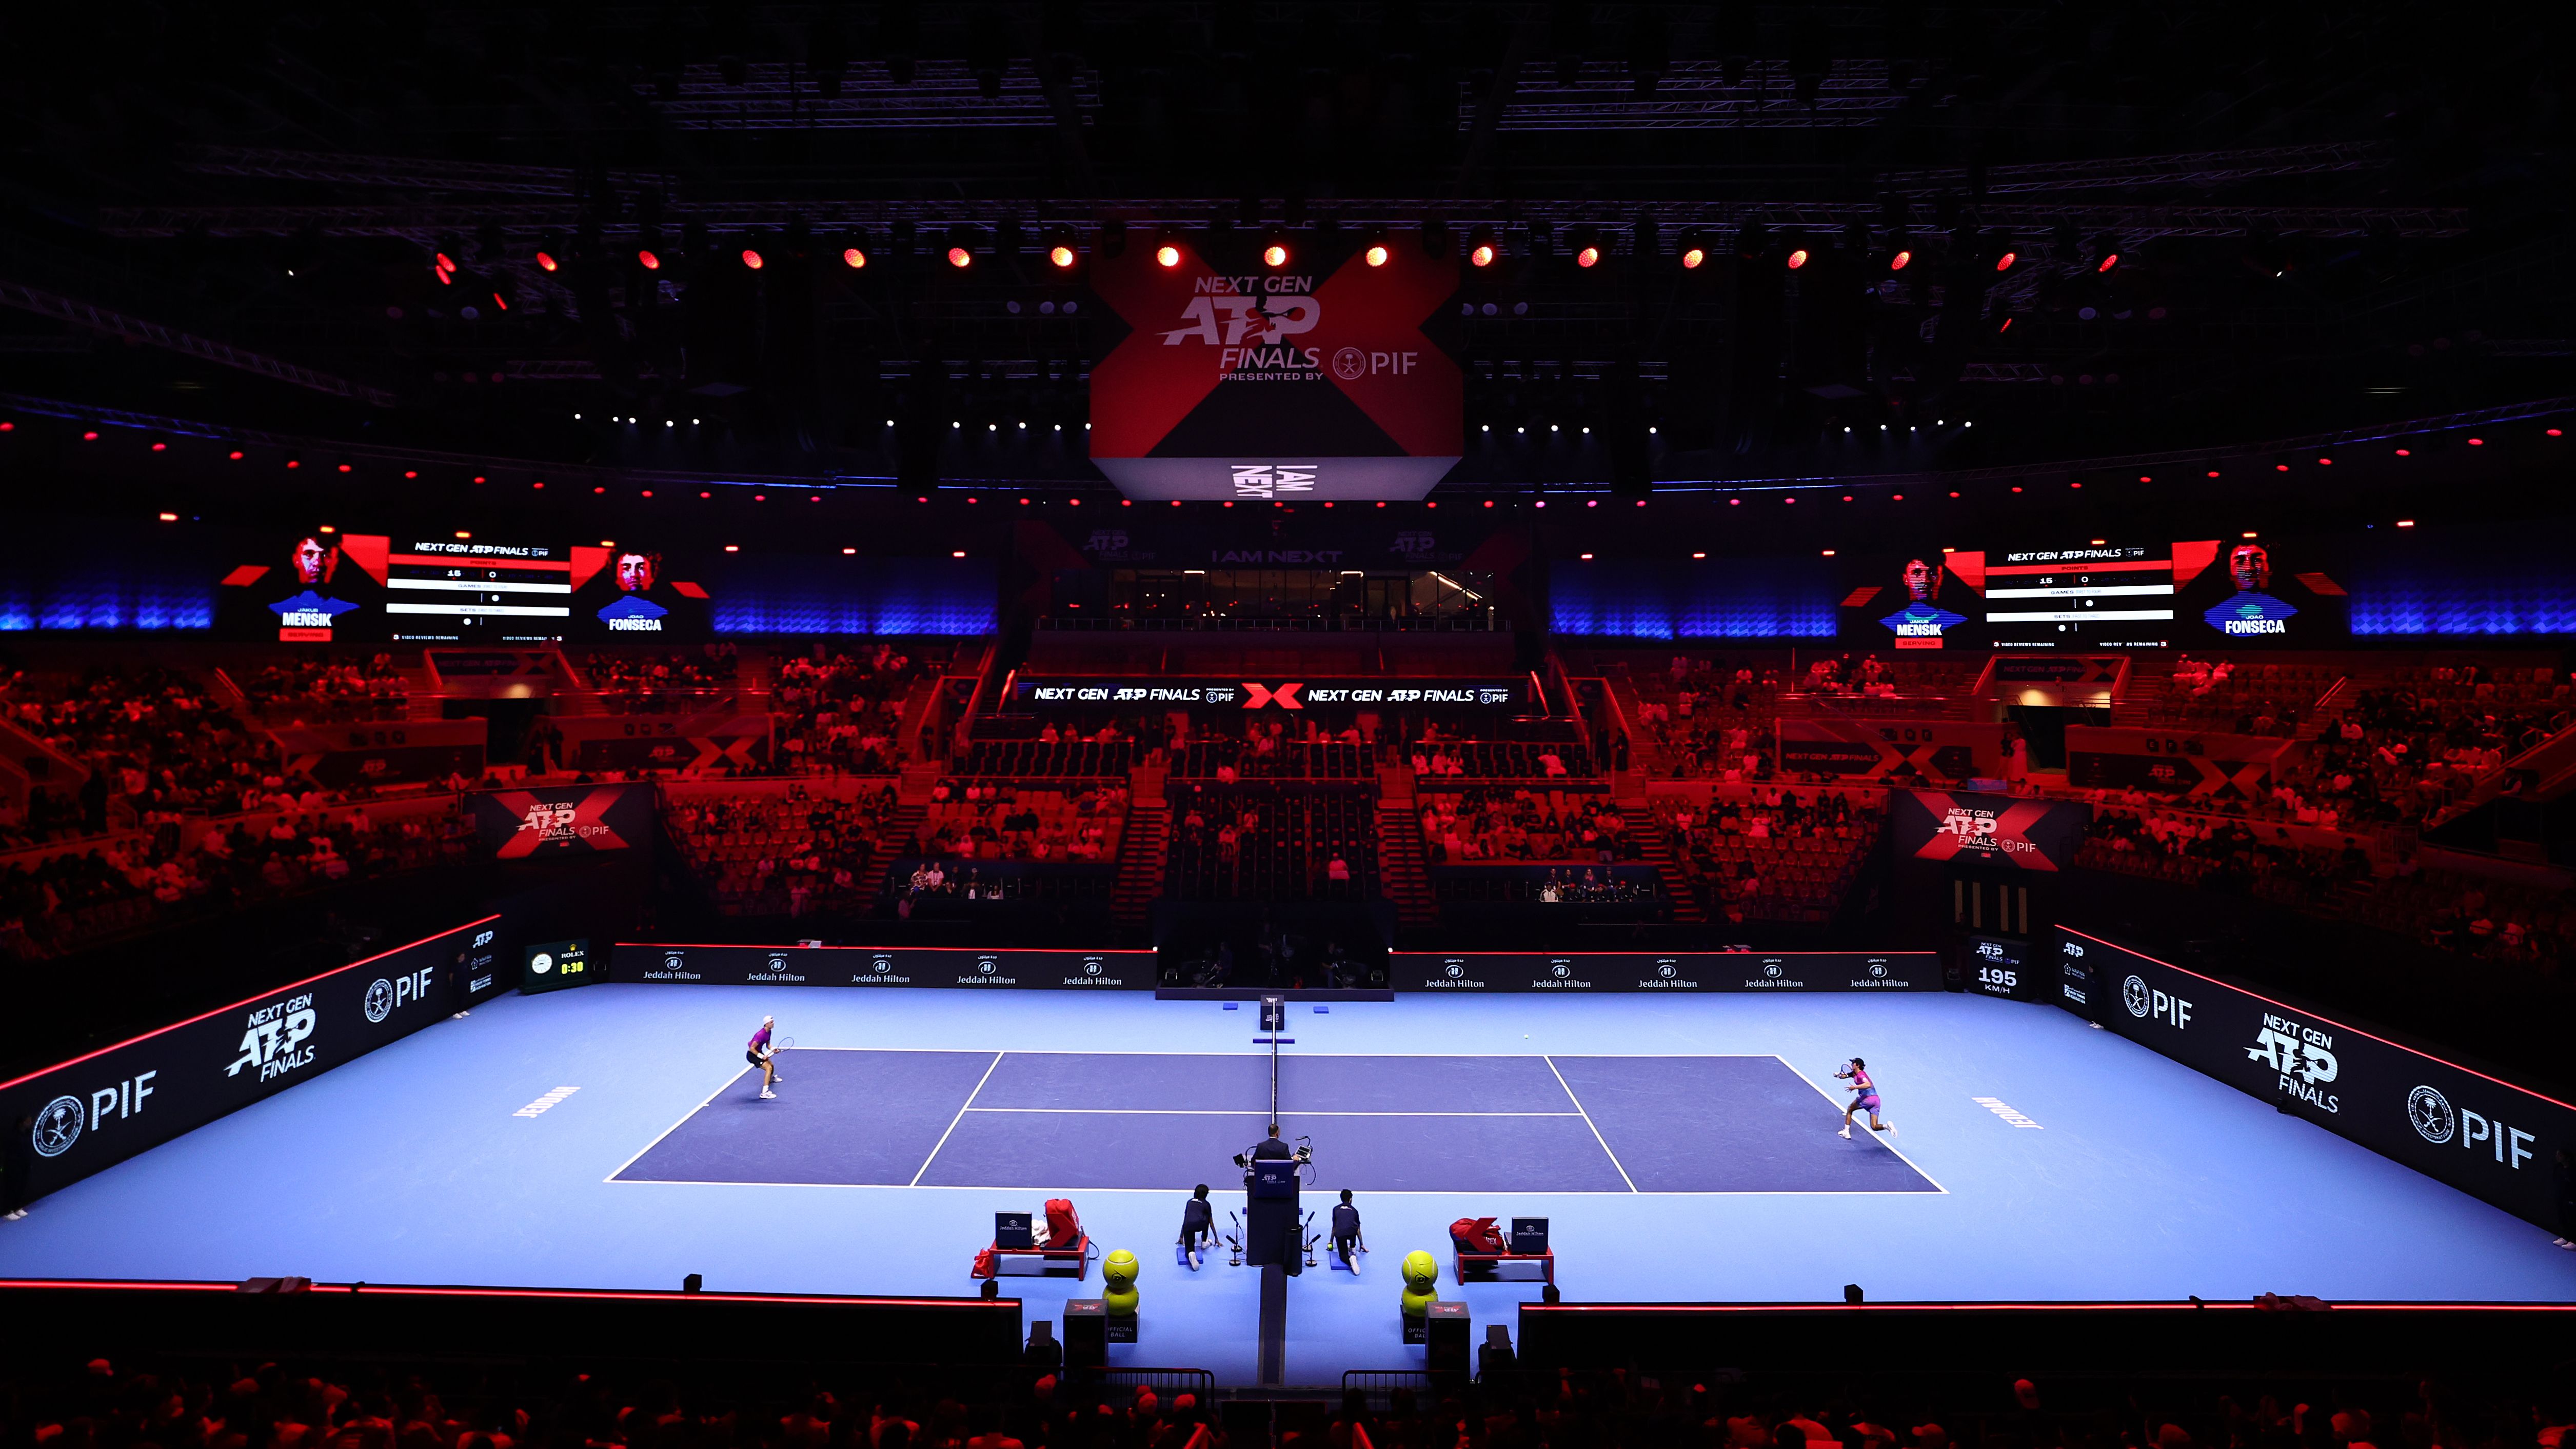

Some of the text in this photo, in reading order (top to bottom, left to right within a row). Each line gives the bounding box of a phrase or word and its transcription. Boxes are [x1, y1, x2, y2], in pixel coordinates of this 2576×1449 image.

[1195, 276, 1312, 293] NEXT GEN
[1155, 296, 1321, 345] ATP
[1220, 347, 1418, 374] FINALS PIF
[1305, 372, 1323, 381] BY
[1231, 465, 1273, 498] NEXT
[1276, 470, 1316, 491] AM
[415, 542, 445, 552] NEXT
[446, 544, 468, 552] GEN
[469, 545, 494, 553] ATP
[493, 546, 529, 555] FINALS
[2008, 552, 2036, 561] NEXT
[2036, 552, 2058, 560] GEN
[2059, 550, 2084, 560] ATP
[2084, 549, 2122, 558] FINALS
[1212, 550, 1343, 563] I AM NEXT
[283, 612, 332, 626] MENSIK
[609, 619, 662, 631] FONSECA
[1896, 624, 1943, 636] MENSIK
[2225, 620, 2285, 633] FONSECA
[1035, 688, 1201, 700] NEXT GEN ATP FINALS
[1218, 693, 1234, 702] PIF
[1308, 689, 1475, 702] NEXT GEN ATP FINALS
[1492, 694, 1508, 702] PIF
[529, 803, 554, 811] NEXT
[1948, 807, 1973, 816] NEXT
[516, 809, 576, 831] ATP
[1934, 815, 1997, 837] ATP
[539, 826, 609, 838] FINALS PIF
[1958, 835, 2036, 852] FINALS PIF
[472, 930, 493, 948] ATP
[1976, 945, 2003, 956] ATP
[2063, 942, 2084, 958] ATP
[561, 961, 583, 974] 0:30
[747, 972, 805, 982] Jeddah Hilton
[851, 974, 910, 983] Jeddah Hilton
[957, 975, 1016, 984] Jeddah Hilton
[1063, 976, 1122, 985] Jeddah Hilton
[1425, 979, 1455, 987] Jeddah
[1978, 967, 2017, 986] 195
[396, 966, 433, 1007] PIF
[1532, 980, 1591, 988] Jeddah Hilton
[1638, 979, 1697, 988] Jeddah Hilton
[1745, 979, 1804, 988] Jeddah Hilton
[1850, 979, 1909, 988] Jeddah Hilton
[1985, 984, 2010, 994] KM/H
[248, 993, 312, 1027] NEXT GEN
[2152, 989, 2192, 1029] PIF
[2264, 1013, 2332, 1049] NEXT GEN
[224, 1008, 316, 1077] ATP
[2243, 1027, 2338, 1085] ATP
[260, 1045, 315, 1083] FINALS
[2278, 1074, 2339, 1113] FINALS
[91, 1070, 156, 1131] PIF
[512, 1086, 581, 1118] JEDDAH
[1971, 1097, 2044, 1129] JEDDAH
[2461, 1108, 2535, 1169] PIF
